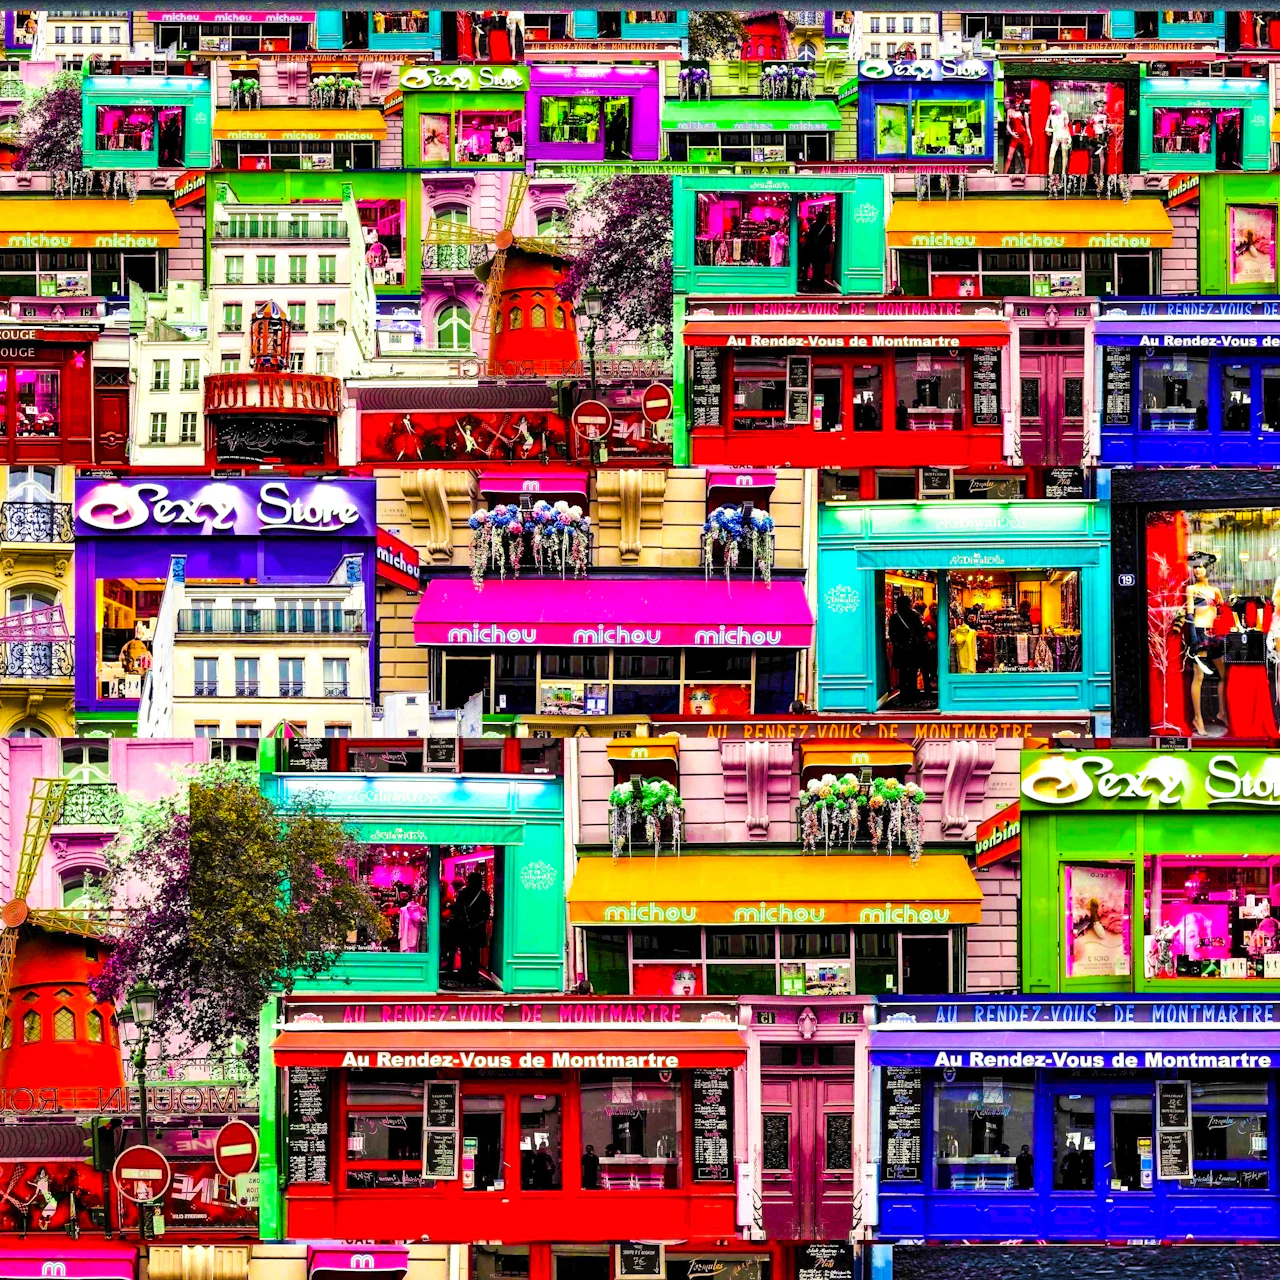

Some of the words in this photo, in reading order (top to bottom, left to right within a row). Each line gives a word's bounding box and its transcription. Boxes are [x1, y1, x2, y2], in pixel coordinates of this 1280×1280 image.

[727, 335, 747, 346] Au
[752, 335, 845, 346] Rendez-Vous
[850, 335, 868, 346] de
[873, 335, 960, 346] Montmartre
[79, 482, 234, 529] Sexy
[256, 482, 358, 531] Store
[603, 901, 696, 922] michou
[734, 902, 826, 923] michou
[858, 902, 950, 923] michou
[935, 1051, 962, 1068] Au
[970, 1051, 1105, 1068] Rendez-Vous
[1112, 1051, 1138, 1068] de
[1145, 1051, 1272, 1068] Montmartre
